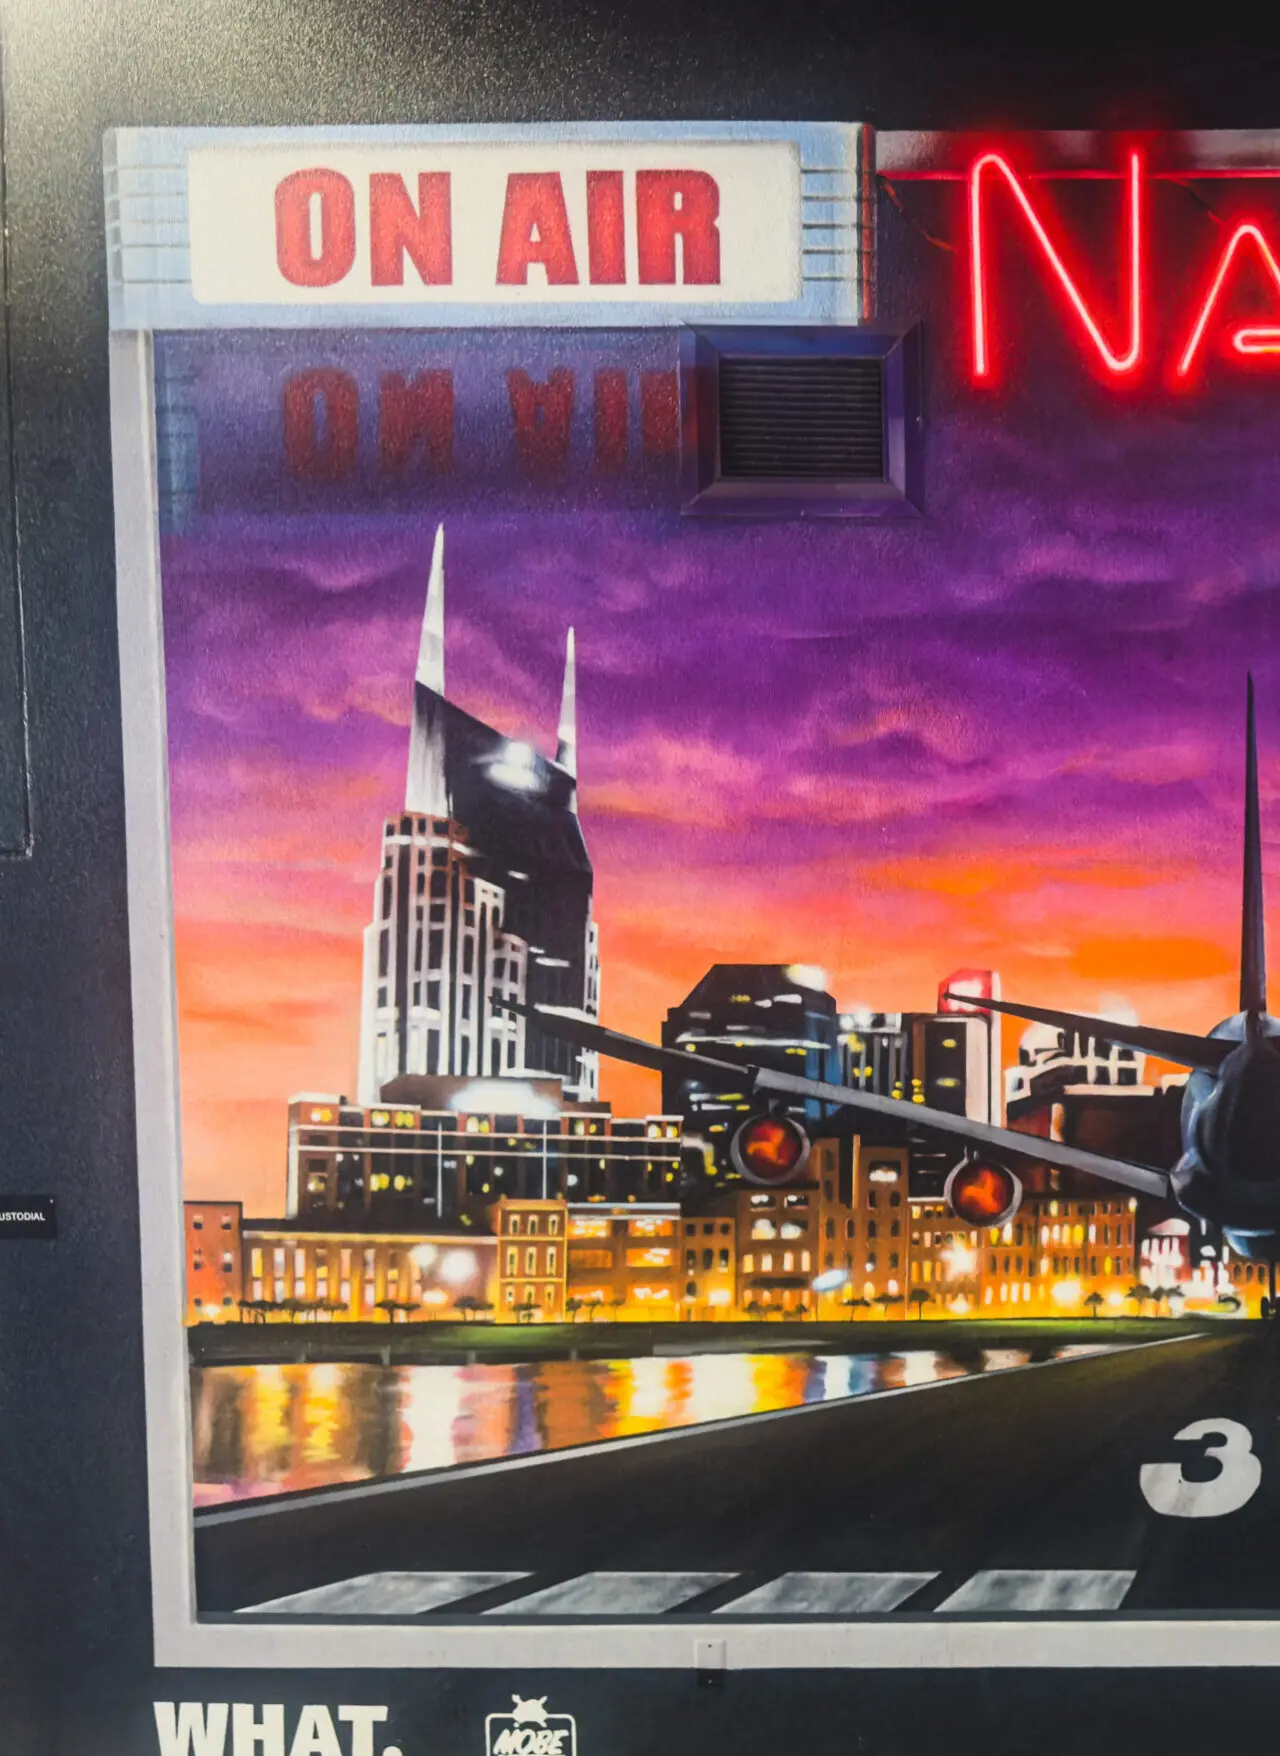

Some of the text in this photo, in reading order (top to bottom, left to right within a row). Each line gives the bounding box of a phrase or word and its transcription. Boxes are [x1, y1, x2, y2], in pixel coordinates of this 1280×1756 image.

[274, 167, 721, 288] ON AIR
[153, 1701, 403, 1756] WHAT.
